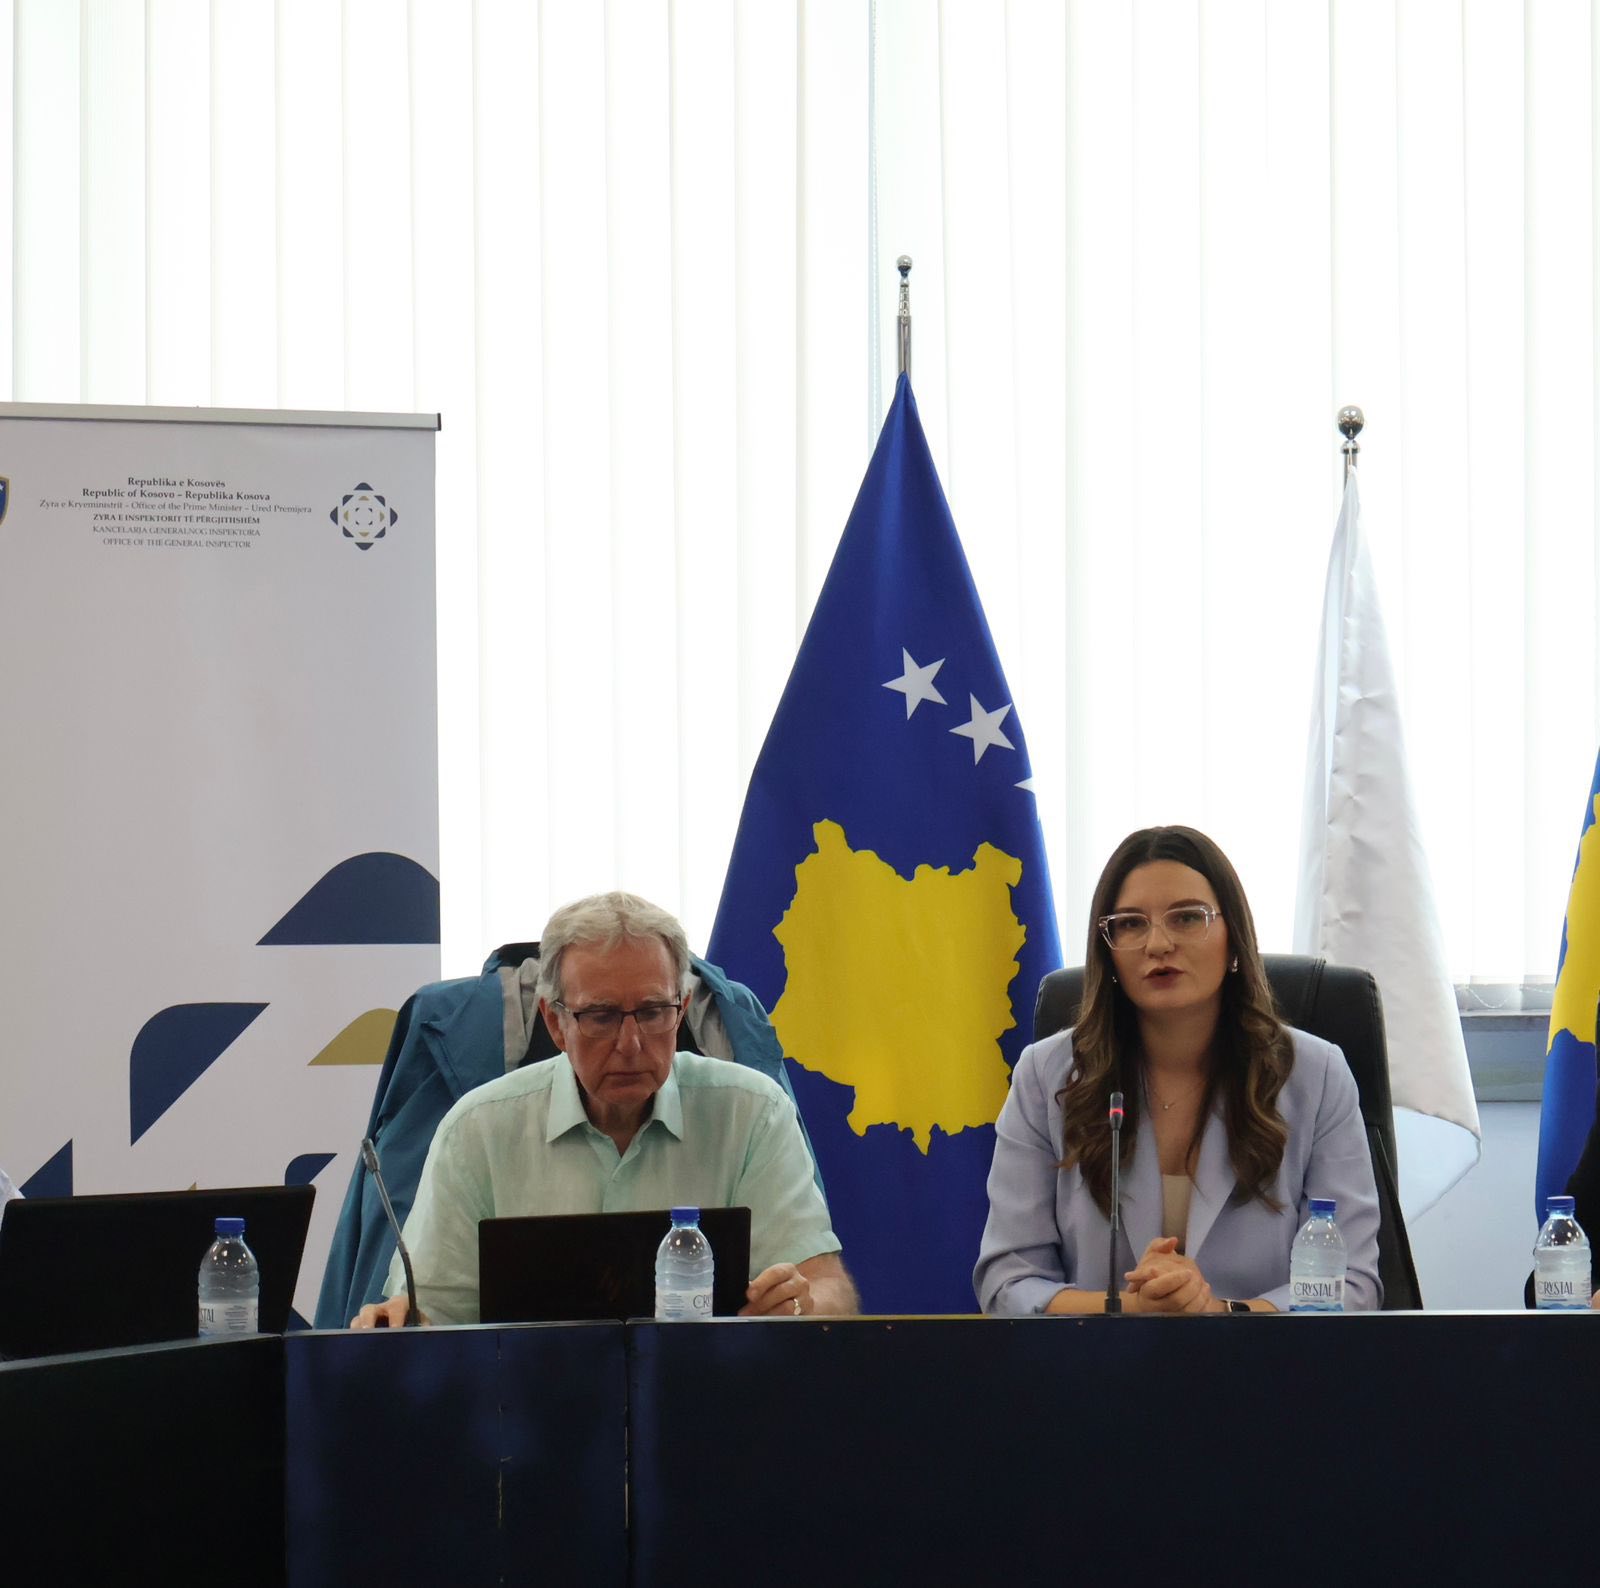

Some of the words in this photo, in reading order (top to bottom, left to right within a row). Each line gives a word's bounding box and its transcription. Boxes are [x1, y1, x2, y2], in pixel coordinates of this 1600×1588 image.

[128, 477, 176, 488] Republika
[187, 478, 226, 487] Kosovës
[82, 488, 125, 499] Republic
[127, 489, 137, 497] of
[140, 490, 175, 498] Kosovo
[185, 491, 233, 501] Republika
[236, 492, 270, 501] Kosova
[39, 499, 59, 509] Zyra
[68, 499, 123, 510] Kryeministrit
[131, 502, 156, 510] Office
[157, 502, 166, 510] of
[168, 502, 181, 510] the
[183, 502, 207, 510] Prime
[209, 503, 242, 511] Minister
[251, 504, 271, 512] Ured
[274, 505, 312, 514] Premijera
[93, 513, 116, 521] ZYRA
[125, 514, 181, 522] INSPEKTORIT
[149, 527, 208, 535] GENERALNOG
[209, 528, 261, 536] INSPEKTORA
[133, 538, 143, 546] OF
[164, 539, 203, 547] GENERAL
[205, 540, 251, 548] INSPECTOR
[1293, 1281, 1333, 1297] CRYSTAL
[1537, 1280, 1574, 1295] CRYSTAL
[199, 1308, 215, 1323] STAL
